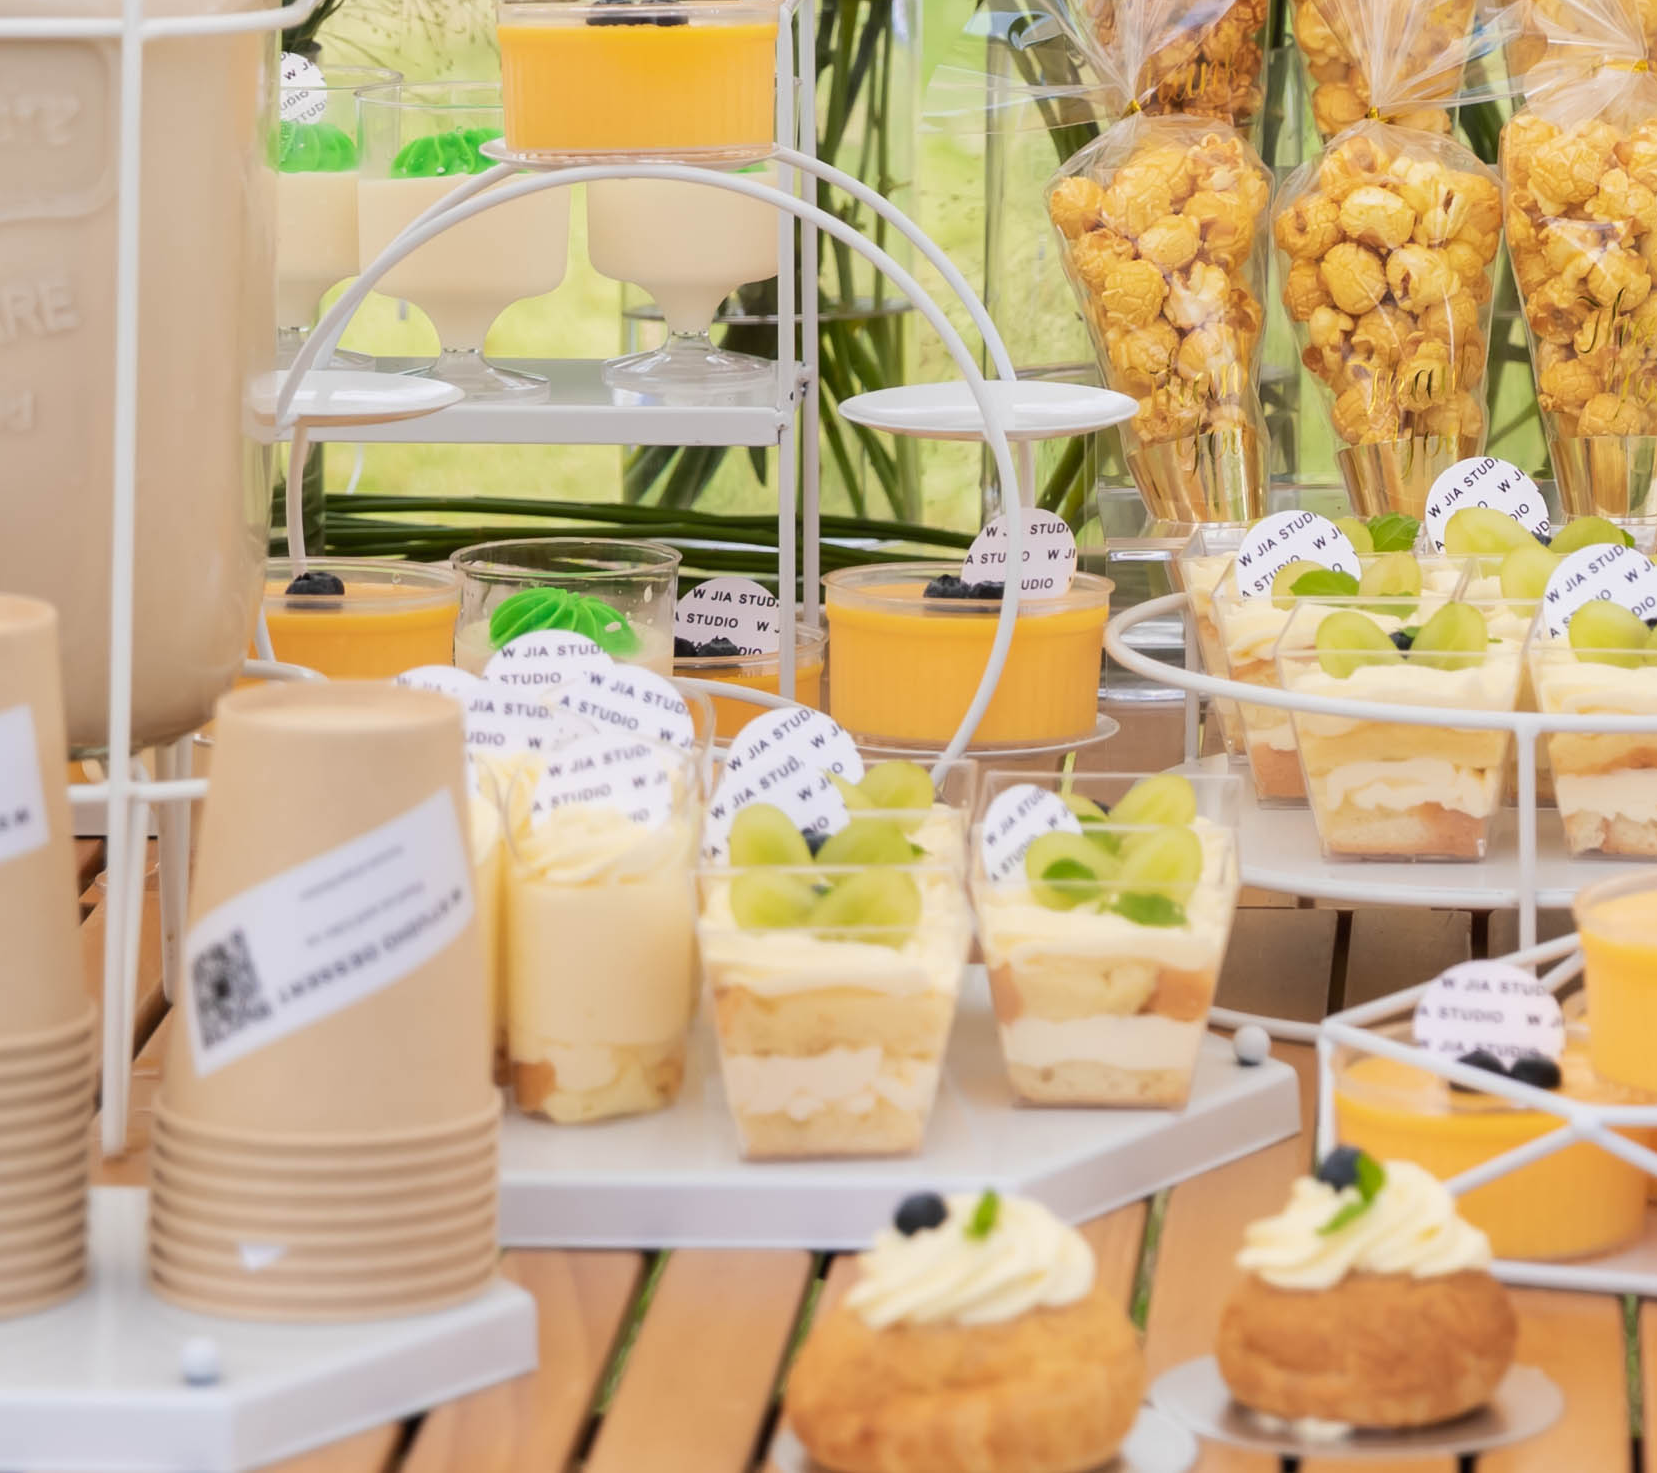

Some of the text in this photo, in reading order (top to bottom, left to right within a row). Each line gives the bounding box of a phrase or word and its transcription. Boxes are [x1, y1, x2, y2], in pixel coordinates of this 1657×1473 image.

[1497, 479, 1511, 493] W
[1428, 487, 1464, 518] W JIA
[986, 522, 1069, 538] W STUD
[1312, 535, 1326, 550] W
[1047, 549, 1060, 560] W
[1239, 538, 1278, 567] W JIA
[1624, 569, 1639, 584] W
[1546, 589, 1560, 604] W
[1565, 573, 1587, 593] JIA
[693, 589, 779, 608] W JIA STUD
[687, 613, 769, 632] STUDIO W
[502, 644, 603, 658] W JIA STUD
[500, 672, 562, 685] STUDIO
[590, 671, 689, 716] W JIA STUD
[469, 699, 554, 719] JIA STUD
[578, 701, 674, 742] STUDIO W
[528, 737, 542, 749] W
[727, 708, 815, 772] W JIA STUD
[811, 734, 826, 750] W
[548, 743, 651, 777] W JIA STUD
[633, 776, 646, 789] W
[710, 755, 805, 820] W JIA STUD
[797, 786, 813, 802] W
[1443, 978, 1546, 997] W JIA STUD
[1439, 1007, 1542, 1026] STUDIO W
[1439, 1040, 1465, 1052] JIA
